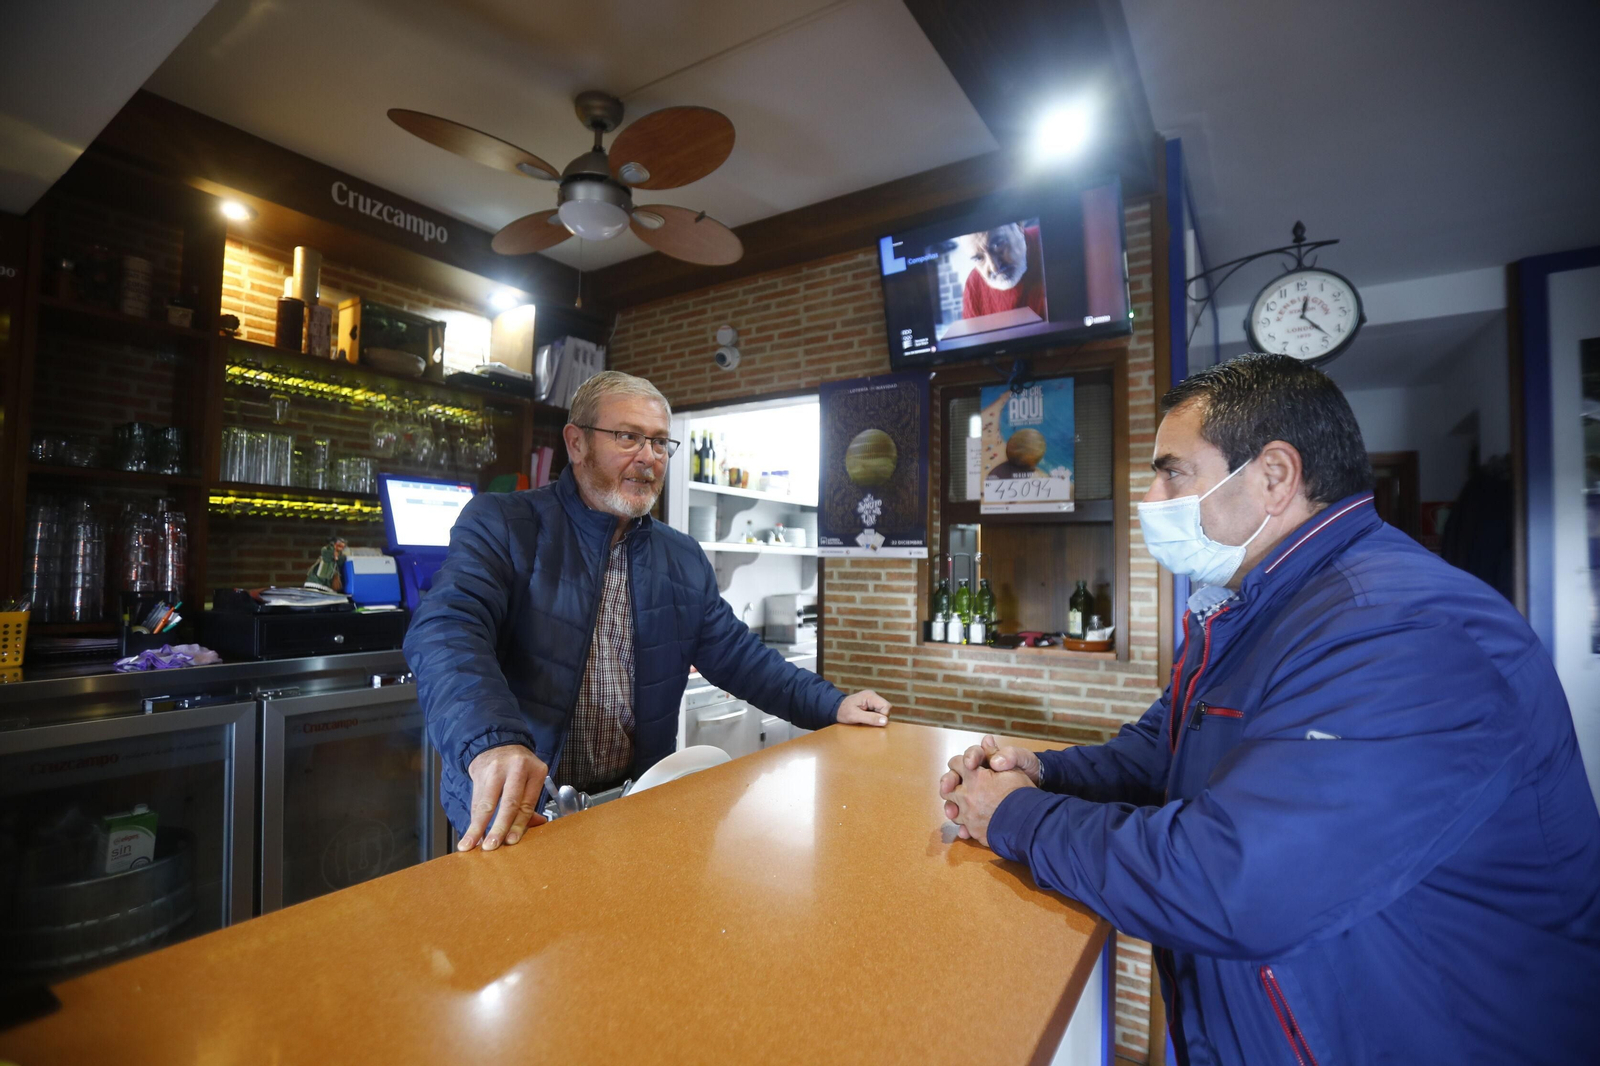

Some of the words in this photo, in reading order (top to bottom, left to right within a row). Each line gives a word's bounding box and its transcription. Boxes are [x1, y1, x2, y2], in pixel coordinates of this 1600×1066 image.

[331, 181, 448, 243] Cruzcampo
[1296, 280, 1307, 291] 12
[1280, 288, 1287, 299] 11
[1332, 292, 1341, 302] 2
[1266, 301, 1277, 312] 10
[1338, 306, 1347, 317] 3
[1261, 317, 1271, 328] 9
[1334, 323, 1345, 333] 4
[1286, 325, 1317, 333] LONDO
[1267, 332, 1276, 342] 8
[1321, 336, 1330, 349] 5
[1281, 341, 1290, 353] 7
[1300, 343, 1310, 354] 6
[995, 480, 1052, 499] 45094
[303, 717, 359, 734] Cruzcampo
[29, 753, 119, 776] Cruzcampo
[111, 845, 132, 857] sin
